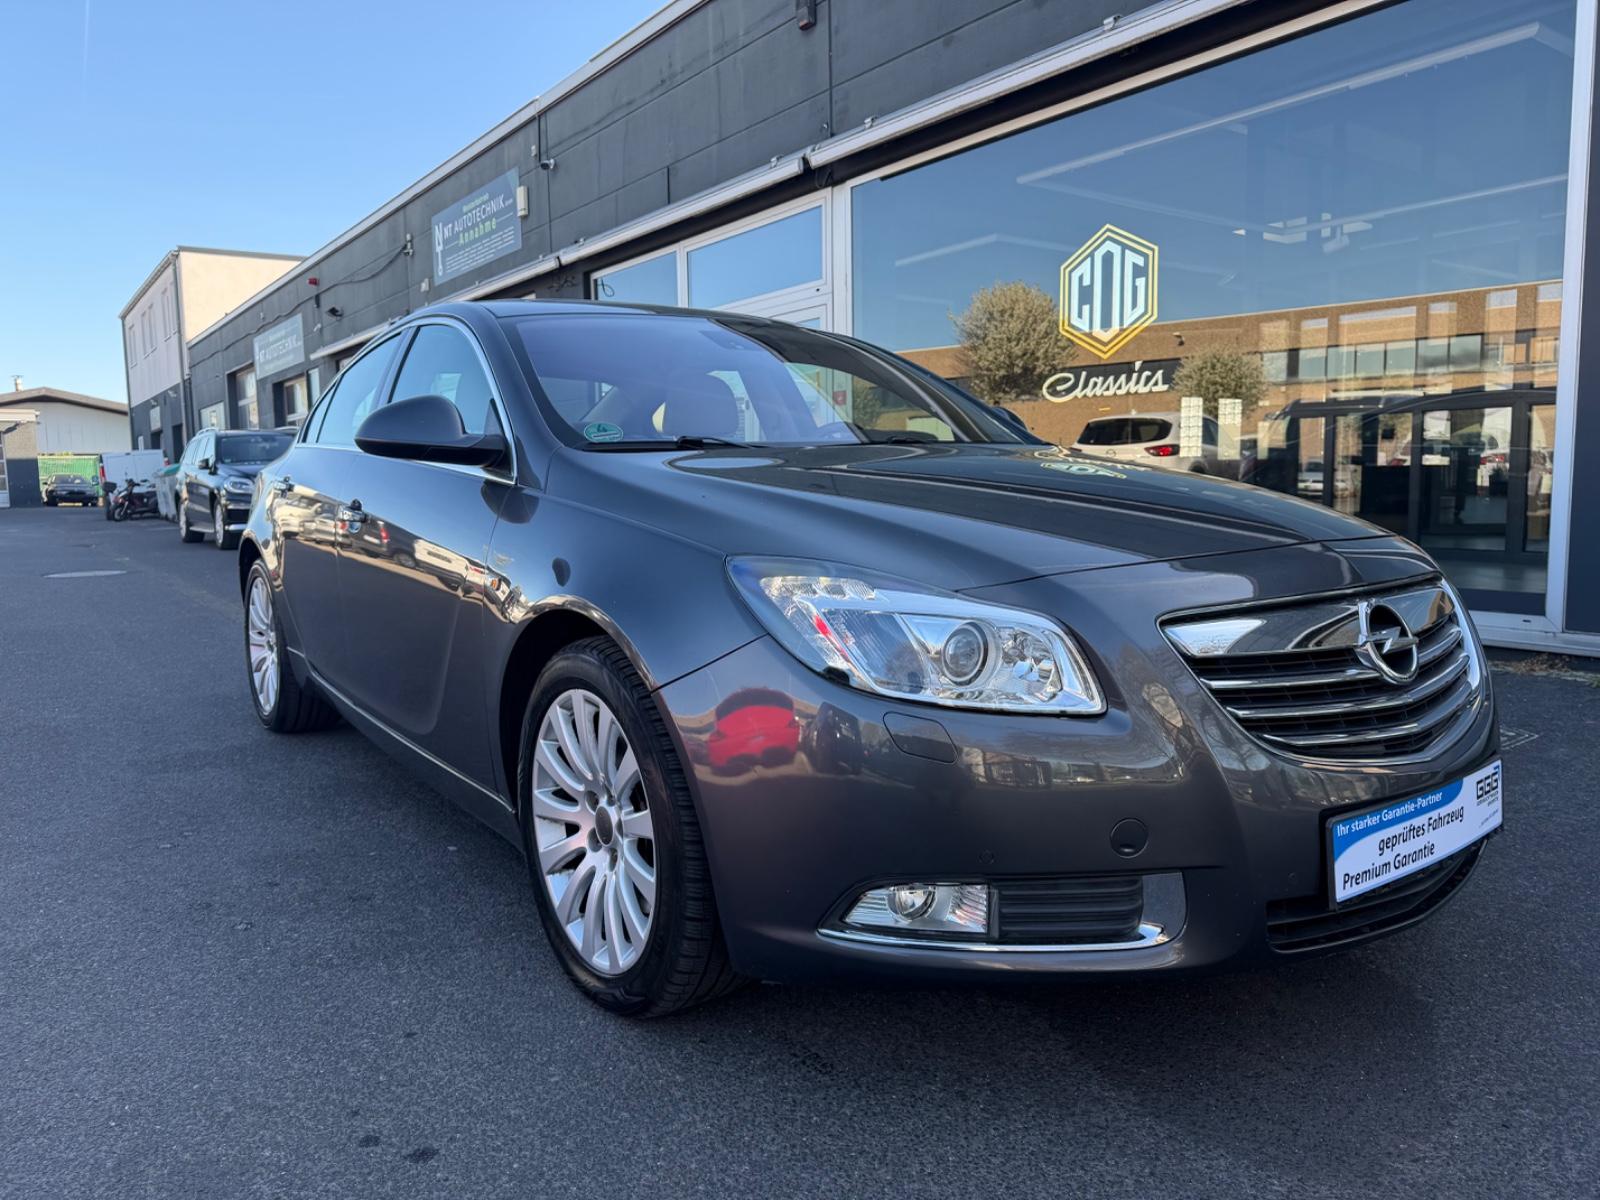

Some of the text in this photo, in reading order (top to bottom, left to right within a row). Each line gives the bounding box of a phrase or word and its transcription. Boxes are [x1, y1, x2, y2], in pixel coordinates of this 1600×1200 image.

[443, 223, 453, 240] NT
[454, 194, 505, 234] AUTOTECHNIK
[1042, 361, 1170, 403] Classics
[1476, 772, 1499, 801] GGG
[1337, 791, 1443, 837] Ihr starker Garantie-Partner
[1378, 825, 1426, 857] geprüftes
[1426, 805, 1465, 834] Fahrzeug
[1343, 841, 1435, 890] Premium Garantie
